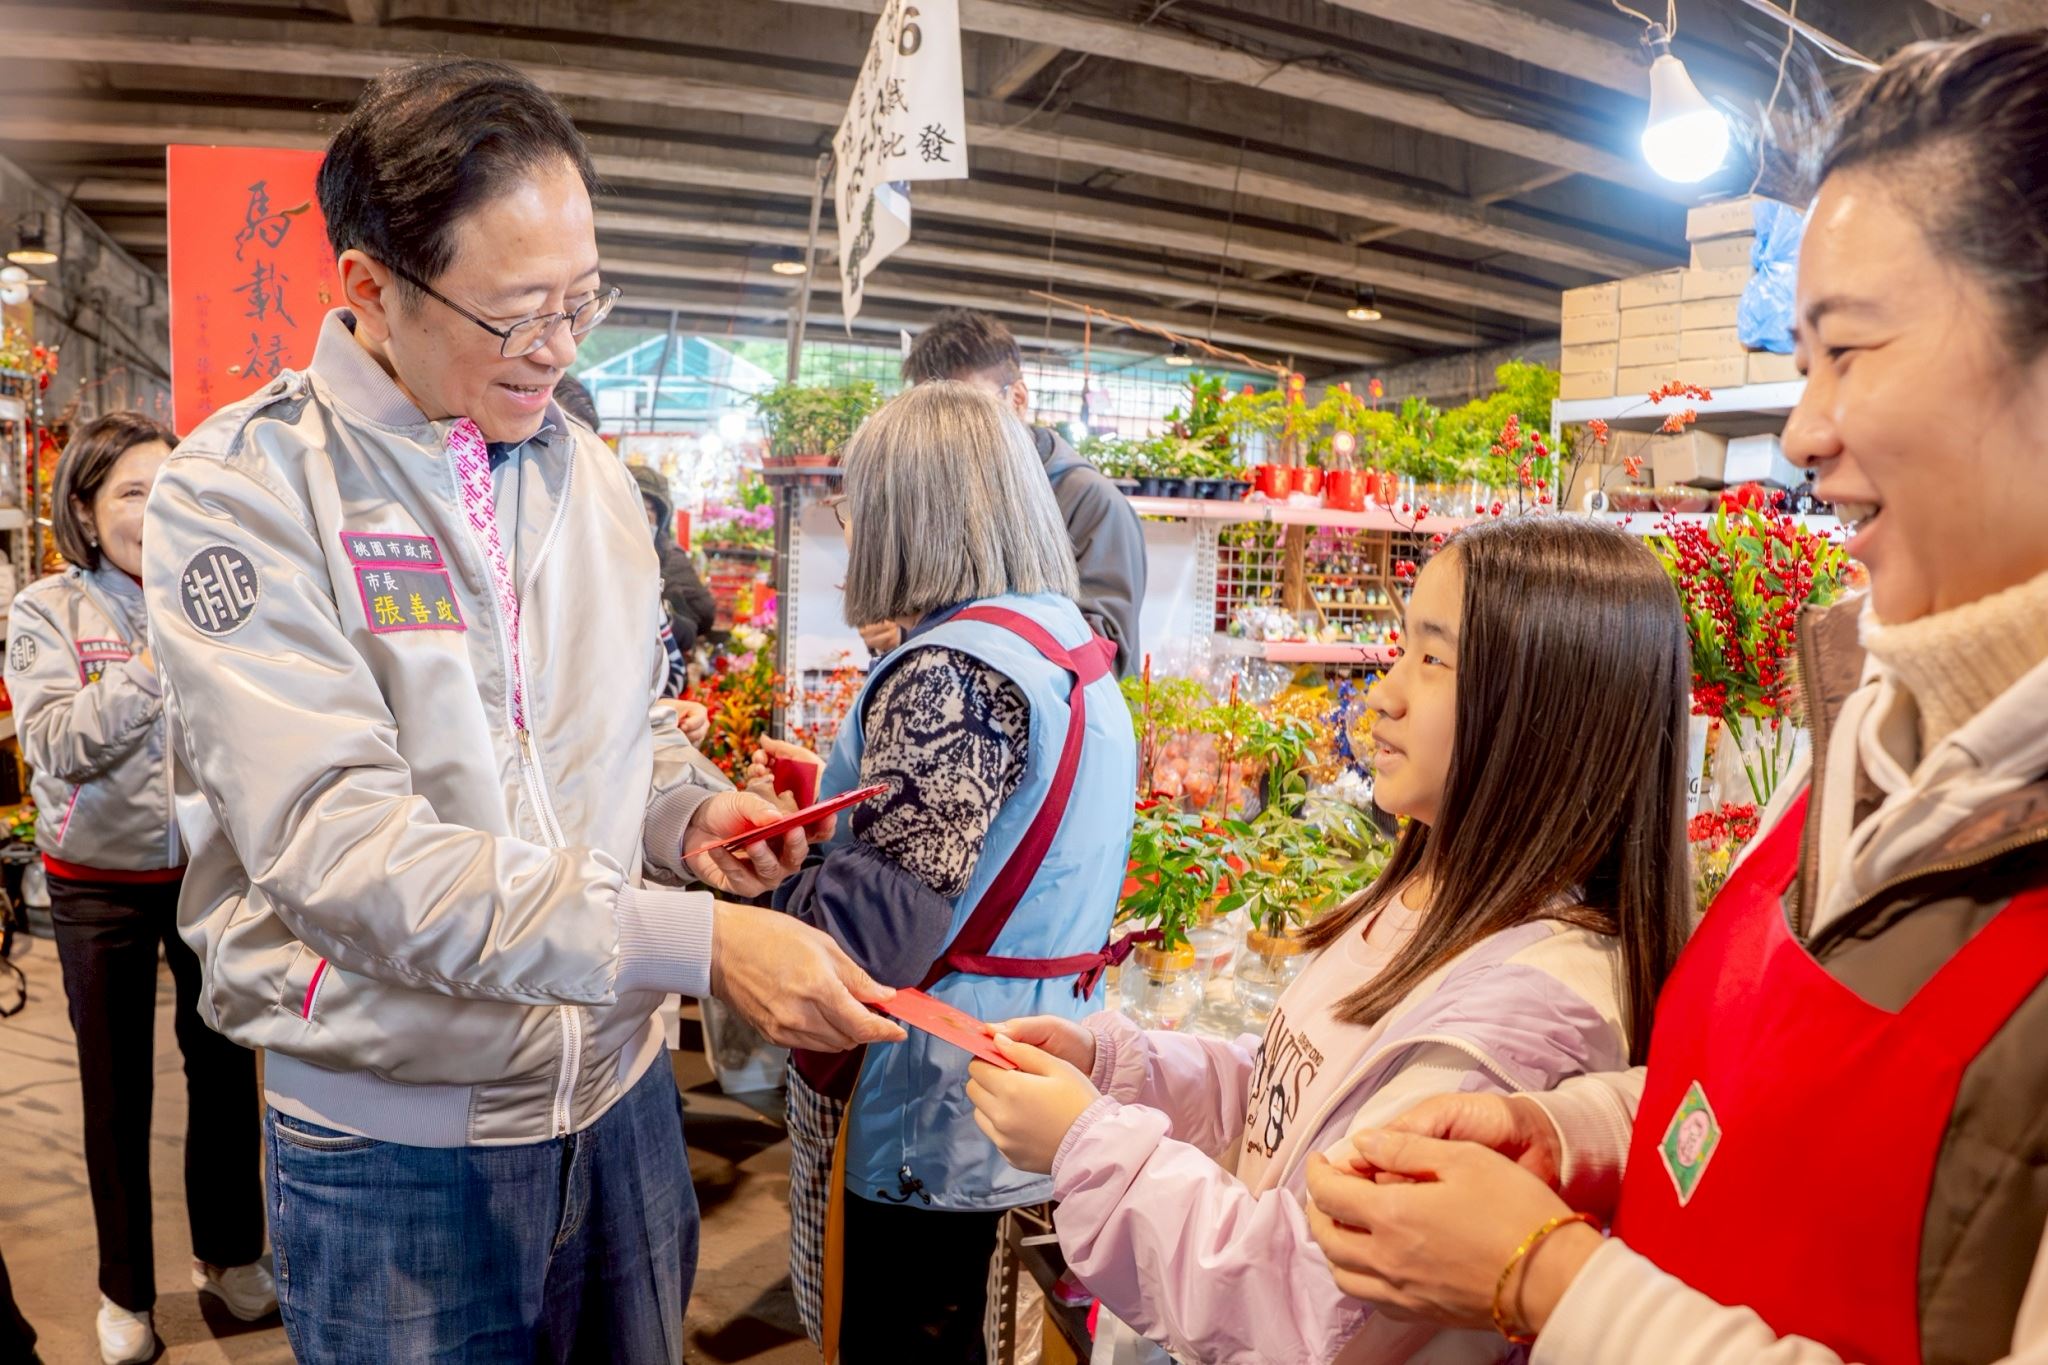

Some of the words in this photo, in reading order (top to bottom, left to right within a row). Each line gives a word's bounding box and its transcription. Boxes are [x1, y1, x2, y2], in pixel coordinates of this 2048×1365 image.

[353, 540, 432, 560] 桃園市政府
[365, 572, 400, 592] 市長
[374, 593, 460, 625] 張善政
